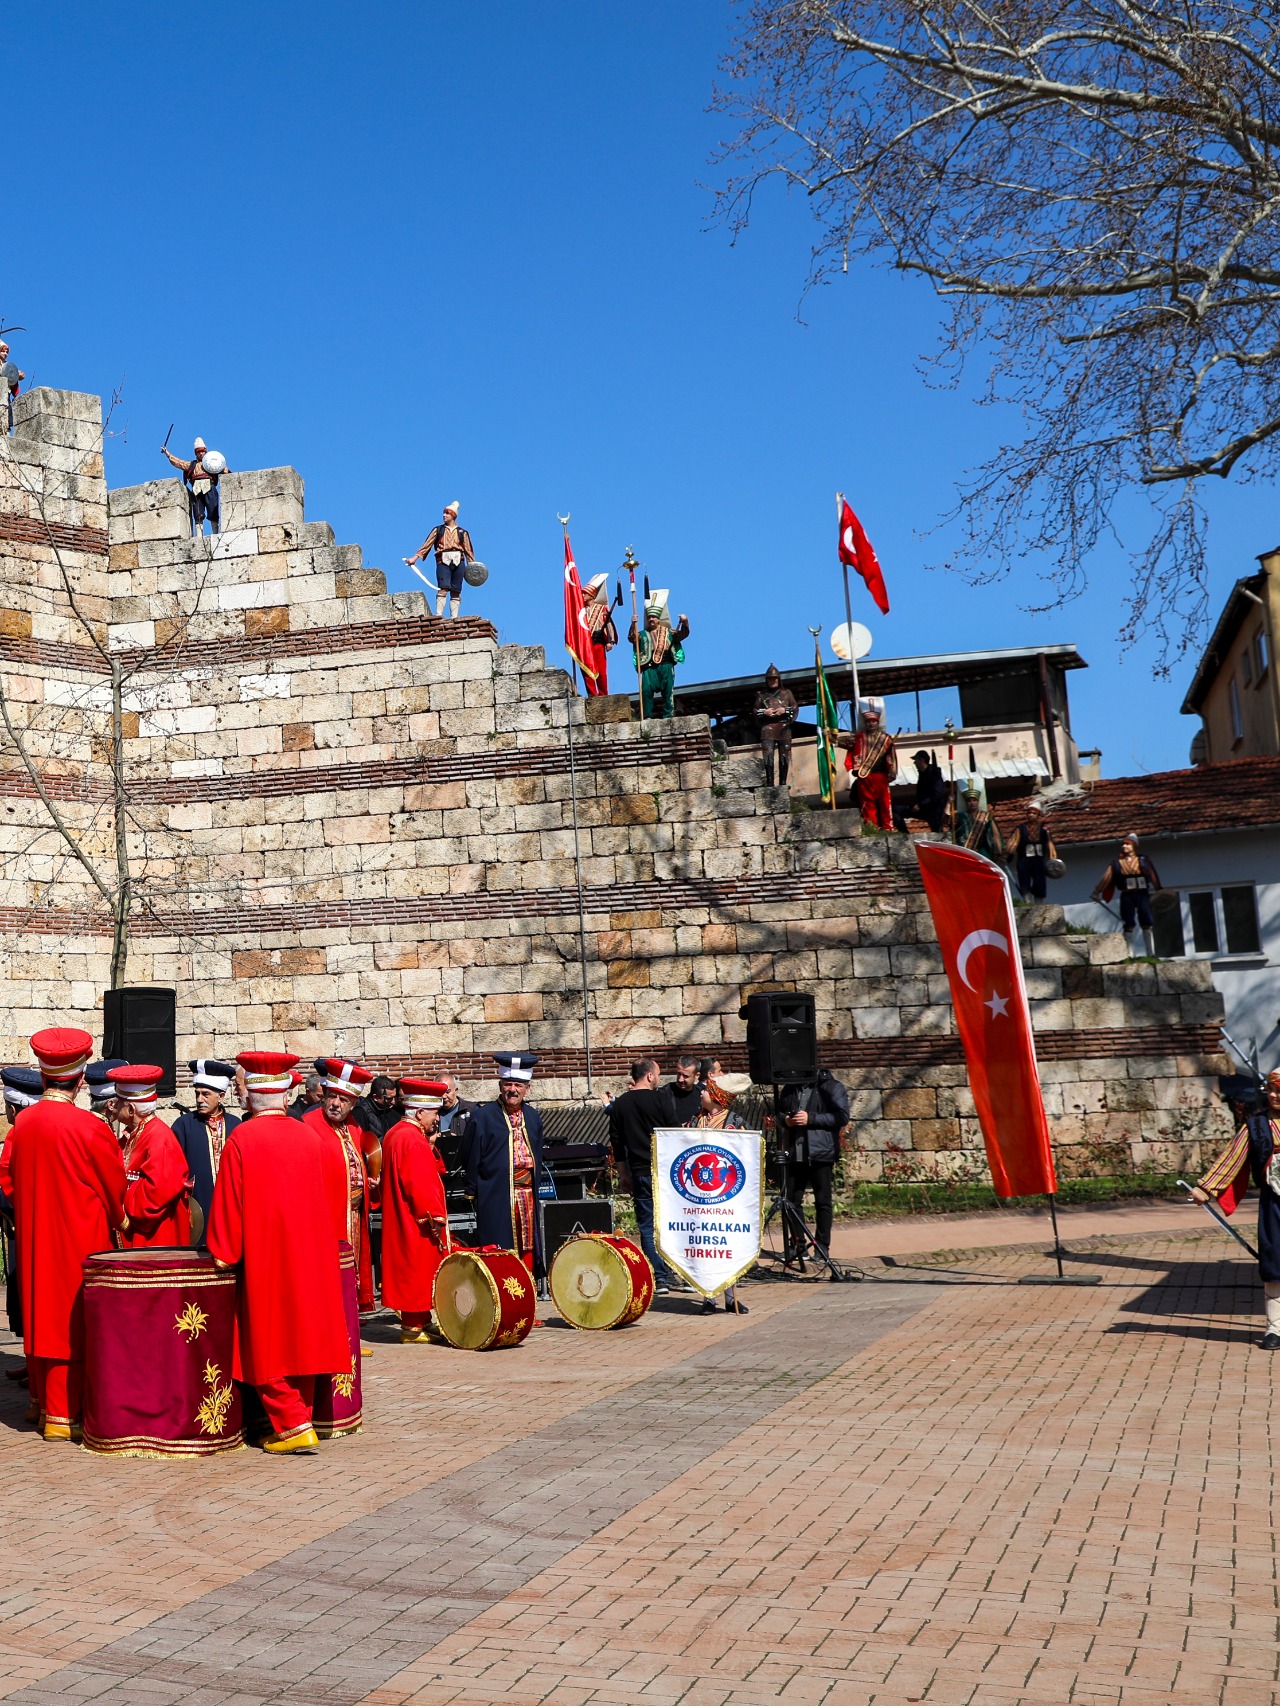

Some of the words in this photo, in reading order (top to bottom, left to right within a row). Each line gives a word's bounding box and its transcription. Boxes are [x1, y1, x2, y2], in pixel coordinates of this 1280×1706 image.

[702, 1145, 717, 1153] HALK
[683, 1207, 734, 1216] TAHTAKIRAN
[668, 1221, 751, 1234] KILIÇ-KALKAN
[688, 1235, 728, 1246] BURSA
[684, 1247, 733, 1259] TÜRKİYE
